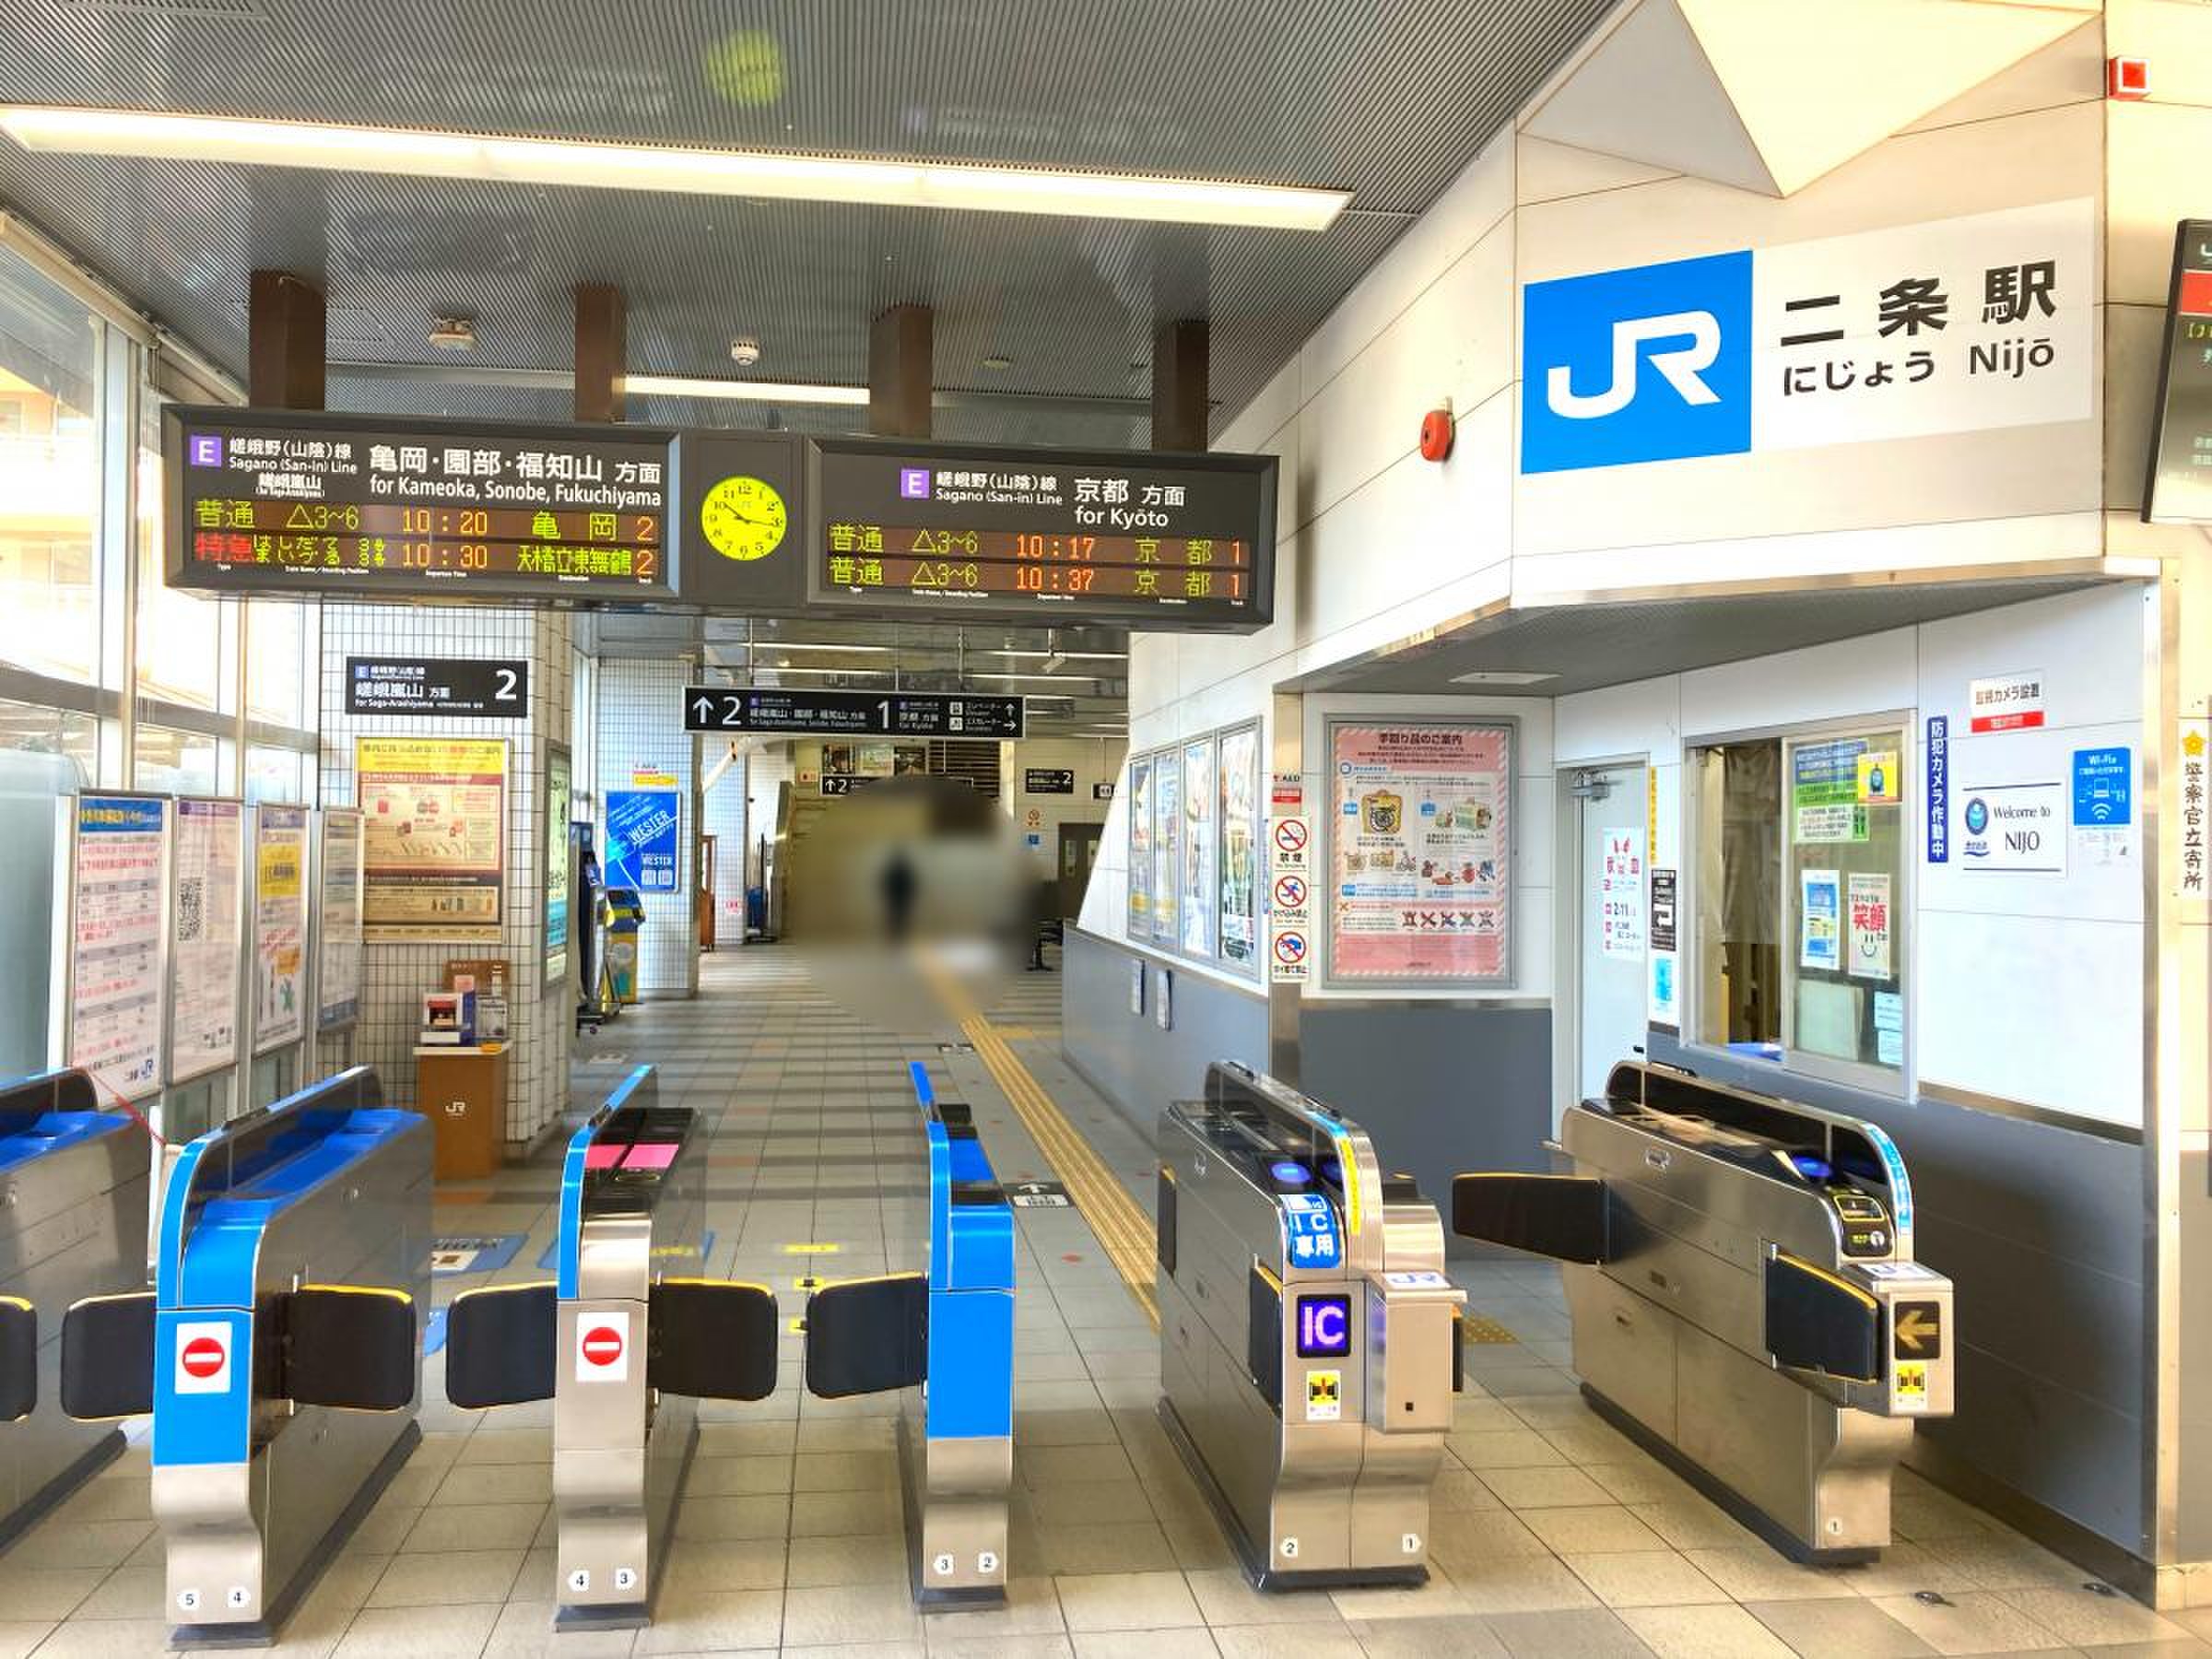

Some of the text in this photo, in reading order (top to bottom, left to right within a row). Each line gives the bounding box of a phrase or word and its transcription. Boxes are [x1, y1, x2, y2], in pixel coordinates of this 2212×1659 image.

[1780, 260, 2056, 347] 二条駅
[1547, 311, 1722, 419] JR
[1783, 337, 2054, 396] にじょう Nijō
[197, 440, 215, 463] E
[229, 457, 276, 472] Sagano
[331, 460, 358, 475] Line
[615, 462, 661, 484] 方面
[370, 475, 661, 510] for Kameoka, Sonobe, Fukuchiyama
[907, 472, 924, 495] E
[1074, 477, 1186, 506] 京都 方面
[936, 488, 983, 504] Sagano
[1037, 492, 1063, 505] Line
[195, 499, 255, 528] 普通
[403, 510, 488, 536] 10:20
[1075, 507, 1169, 530] for Kyōto
[636, 516, 653, 541] 2
[830, 524, 884, 553] 普通
[194, 532, 253, 561] 特急
[403, 544, 488, 568] 10:30
[1017, 535, 1095, 559] 10:17
[1232, 541, 1241, 564] 1
[636, 550, 653, 575] 2
[830, 557, 884, 585] 普通
[1017, 567, 1094, 590] 10:37
[1232, 574, 1241, 597] 1
[495, 669, 517, 700] 2
[723, 697, 741, 725] 2
[877, 700, 888, 729] 1
[838, 780, 848, 793] 2
[1062, 772, 1073, 784] 2
[1931, 722, 1945, 859] 防犯カメラ作動中
[1994, 806, 2036, 818] Welcome
[628, 810, 671, 846] WESTER
[2005, 830, 2041, 854] NIJO
[1853, 903, 1887, 931] 笑顔
[445, 1101, 465, 1113] JR
[1295, 1214, 1328, 1232] IC
[1303, 1305, 1345, 1346] IC
